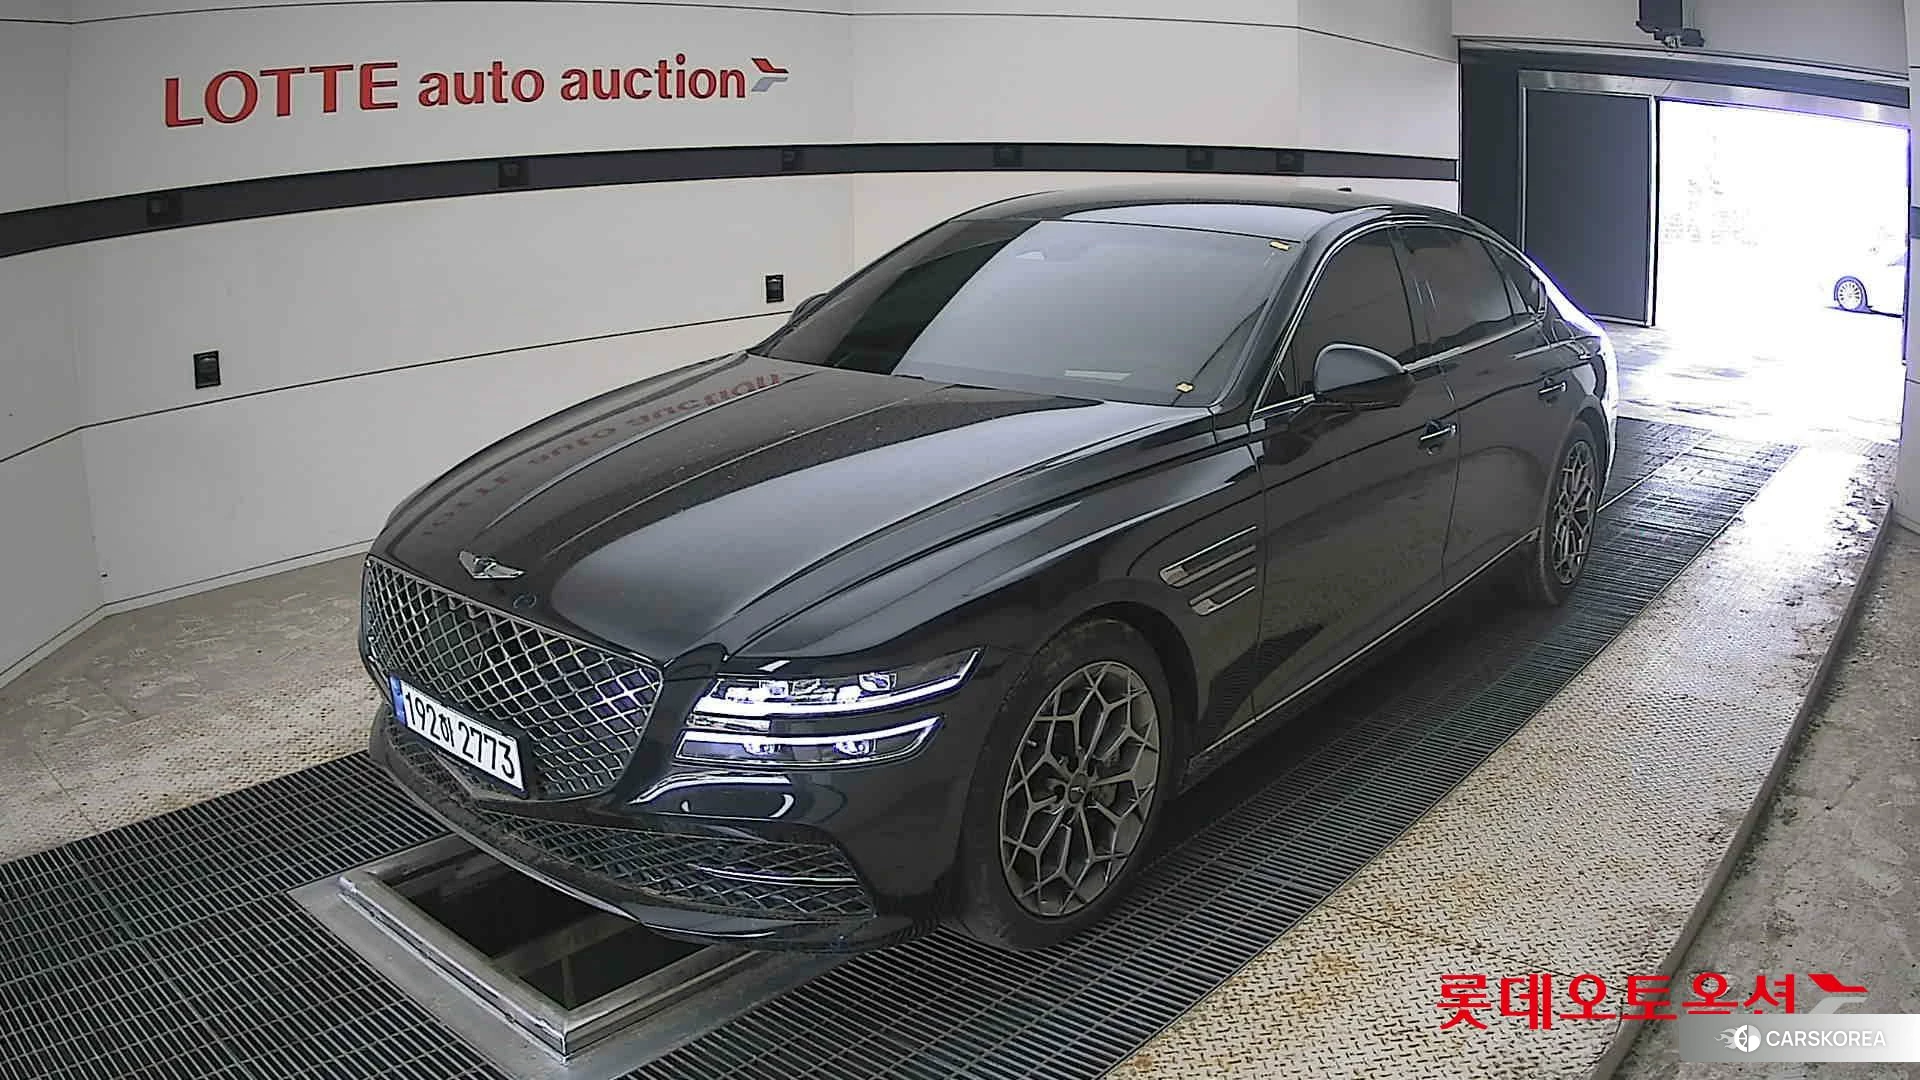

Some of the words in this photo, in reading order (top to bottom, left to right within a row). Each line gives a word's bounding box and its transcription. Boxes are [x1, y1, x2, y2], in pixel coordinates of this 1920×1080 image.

[163, 61, 400, 129] LOTTE
[418, 61, 545, 107] auto
[560, 53, 747, 101] auction
[405, 691, 455, 748] 192하
[457, 720, 516, 780] 2773
